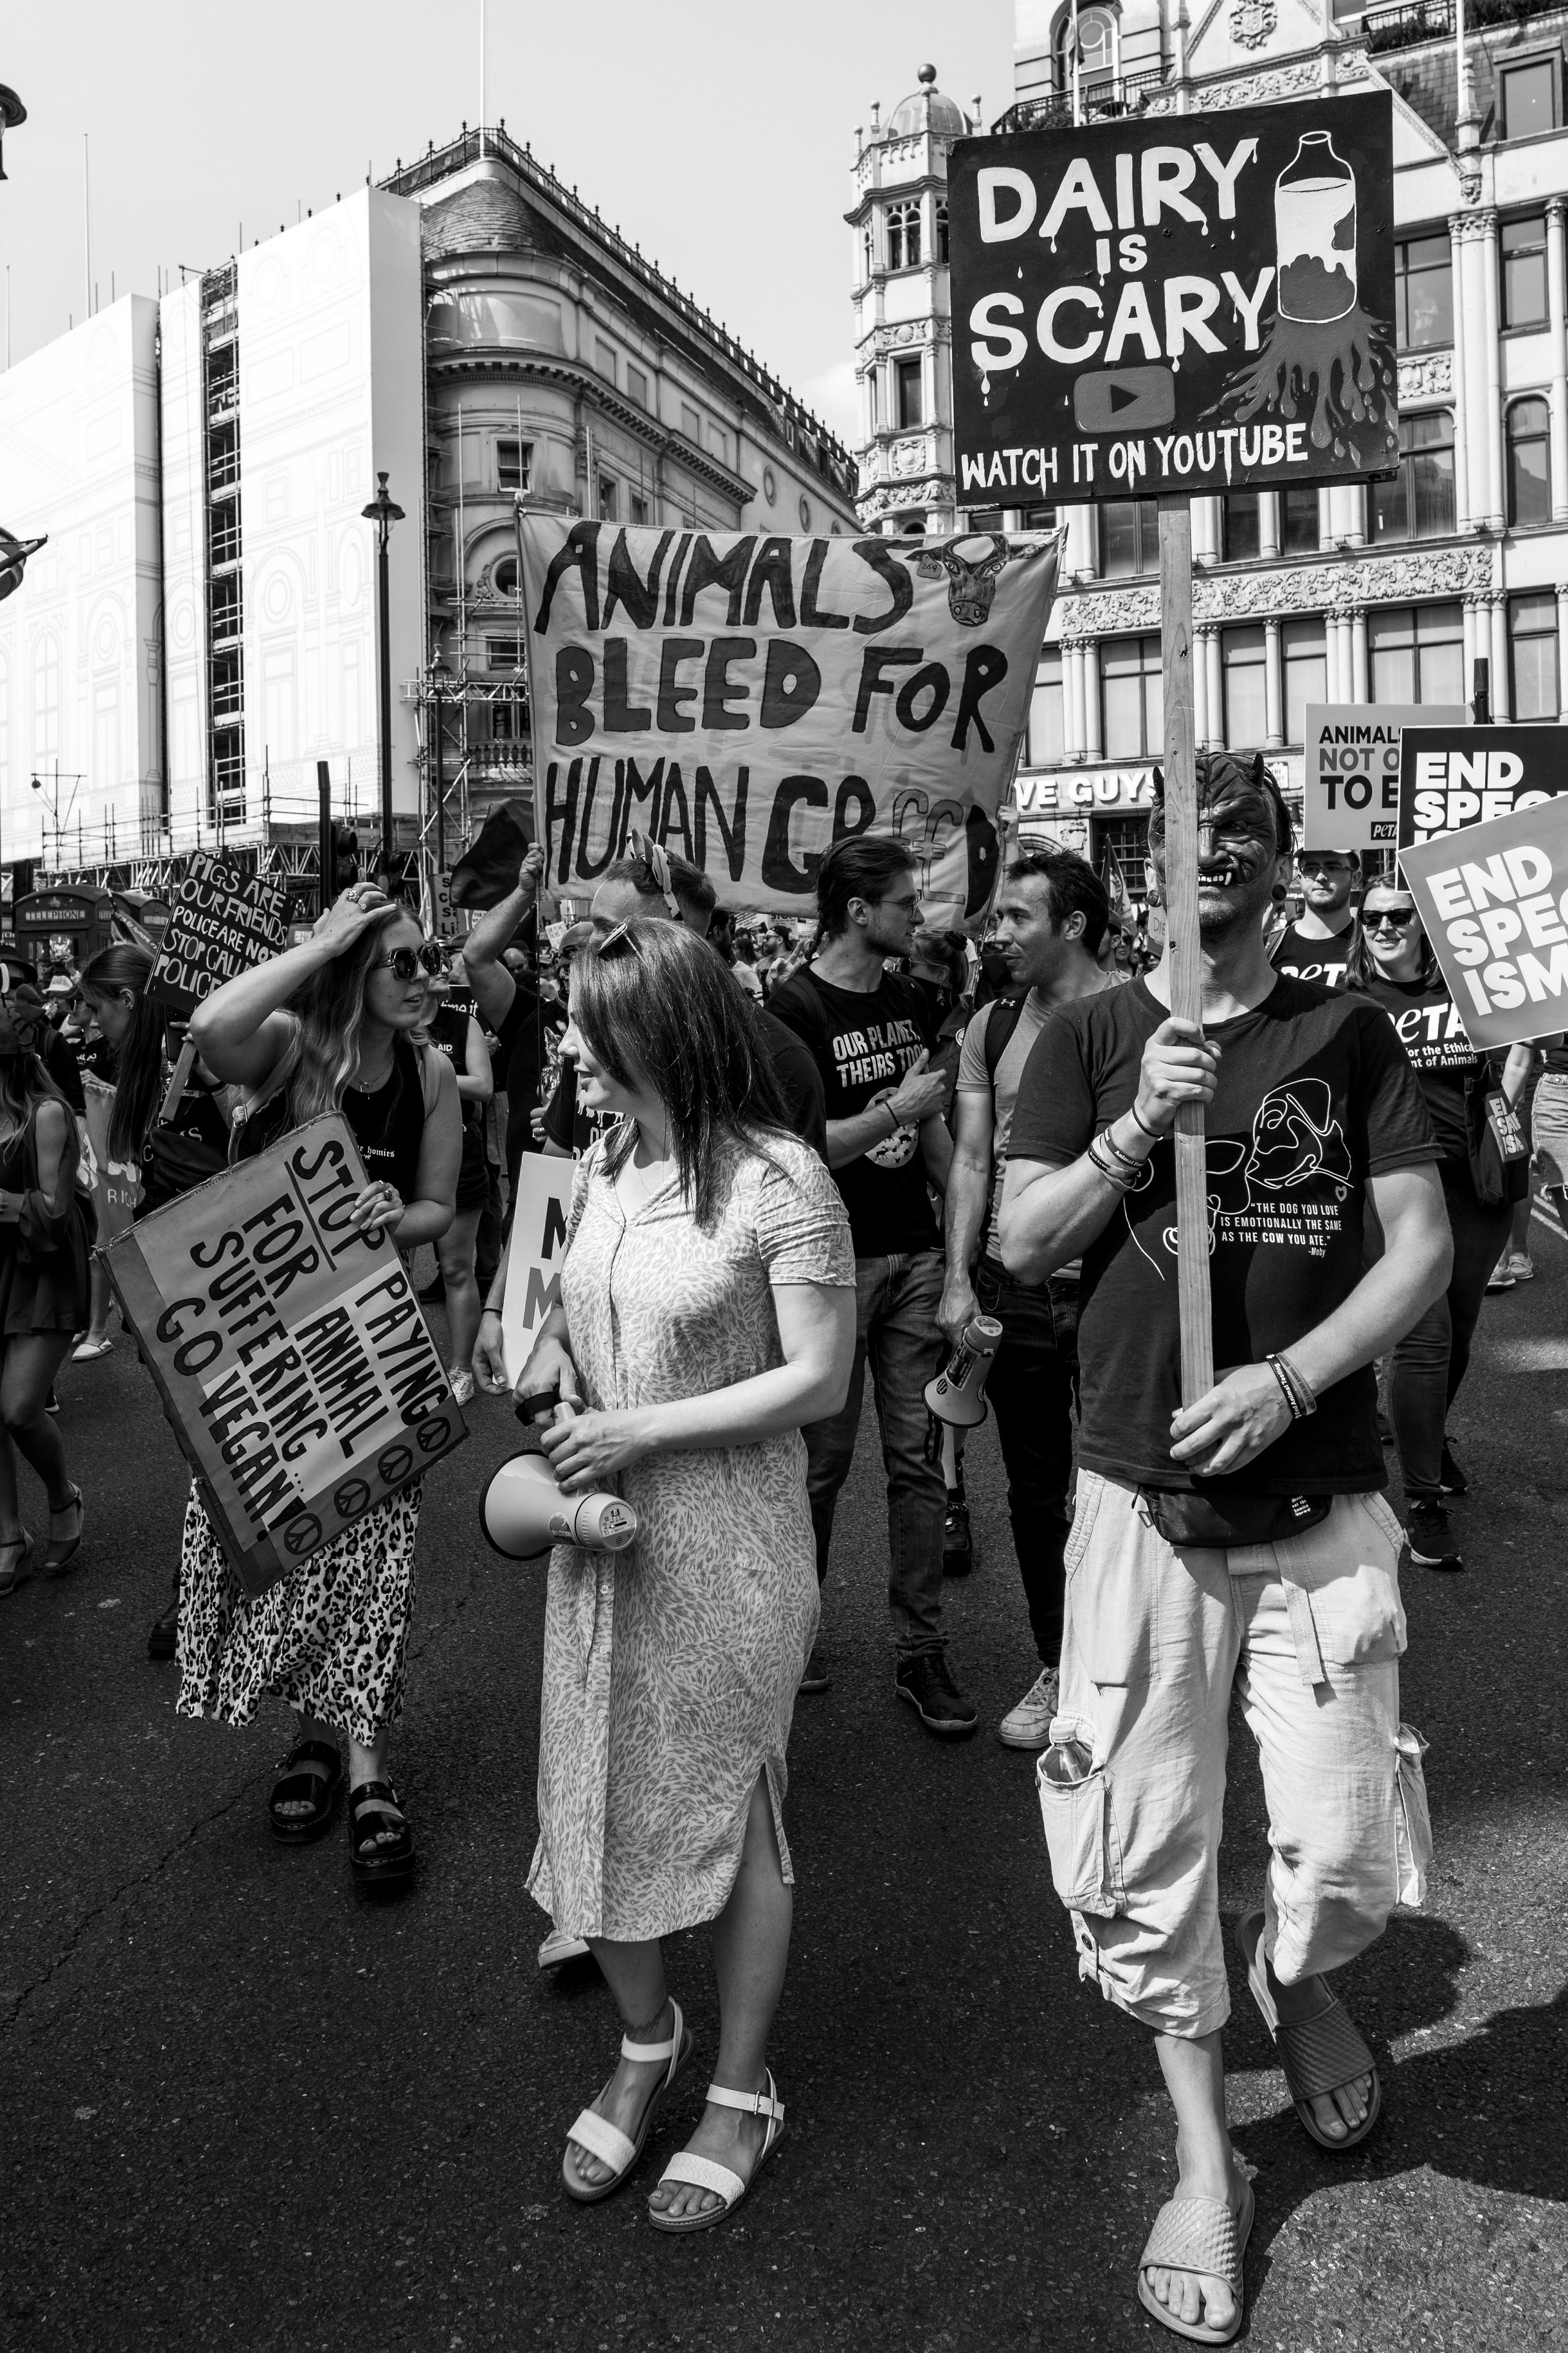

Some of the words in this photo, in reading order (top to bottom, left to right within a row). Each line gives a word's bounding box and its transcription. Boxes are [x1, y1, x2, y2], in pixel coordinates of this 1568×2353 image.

[977, 137, 1259, 244] DAIRY
[1096, 233, 1147, 274] IS
[969, 266, 1276, 371] SCARY
[961, 446, 1058, 493] WATCH
[1072, 442, 1098, 483] IT
[1109, 440, 1146, 485] ON
[1153, 423, 1309, 480] YOUTUBE
[533, 521, 924, 635] ANIMALS
[555, 636, 822, 747] BLEED
[851, 644, 1009, 753] FOR
[1319, 725, 1401, 744] ANIMAL
[1319, 747, 1376, 771] NOT
[1415, 751, 1524, 790] END
[1319, 774, 1373, 810] TO
[1412, 790, 1568, 829] SPE
[543, 756, 750, 891] HUMAN
[189, 853, 241, 893] PIGS
[243, 879, 287, 918] ARE
[1425, 845, 1553, 922] END
[26, 910, 84, 921] TELEPHONE
[180, 878, 225, 916] OUR
[222, 896, 288, 946] FRIENDS
[1446, 893, 1568, 967] SPE
[162, 928, 206, 961] STOP
[206, 945, 254, 978] CALL
[172, 905, 219, 939] POLICE
[216, 925, 246, 953] ARE
[245, 938, 280, 964] NOT
[154, 954, 222, 999] POLICE
[469, 999, 478, 1018] it
[1387, 1003, 1468, 1043] eTA
[832, 1030, 869, 1060] OUR
[866, 1019, 921, 1051] PLANET,
[1405, 1047, 1419, 1057] or
[1422, 1045, 1441, 1056] the
[1425, 1056, 1438, 1067] of
[1440, 1053, 1478, 1066] Animals
[835, 1052, 896, 1088] THEIRS
[367, 1146, 395, 1157] homies
[1114, 1150, 1134, 1165] Animal
[291, 1139, 386, 1256] STOP
[1280, 1203, 1298, 1215] DOG
[1301, 1204, 1319, 1215] YOU
[1321, 1204, 1339, 1216] LOVE
[1221, 1216, 1231, 1226] IS
[1234, 1217, 1302, 1229] EMOTIONALLY
[1305, 1219, 1322, 1230] THE
[1325, 1220, 1343, 1231] SAME
[1221, 1231, 1235, 1242] AS
[1238, 1231, 1259, 1242] THE
[1262, 1232, 1284, 1244] COW
[1287, 1234, 1306, 1245] YOU
[237, 1192, 320, 1300] FOR
[156, 1297, 224, 1377] GO
[355, 1270, 452, 1428] PAYING
[293, 1305, 390, 1460] ANIMAL
[1274, 1363, 1287, 1384] Testing
[1283, 1384, 1297, 1405] Animal
[197, 1369, 307, 1543] VEGAN!
